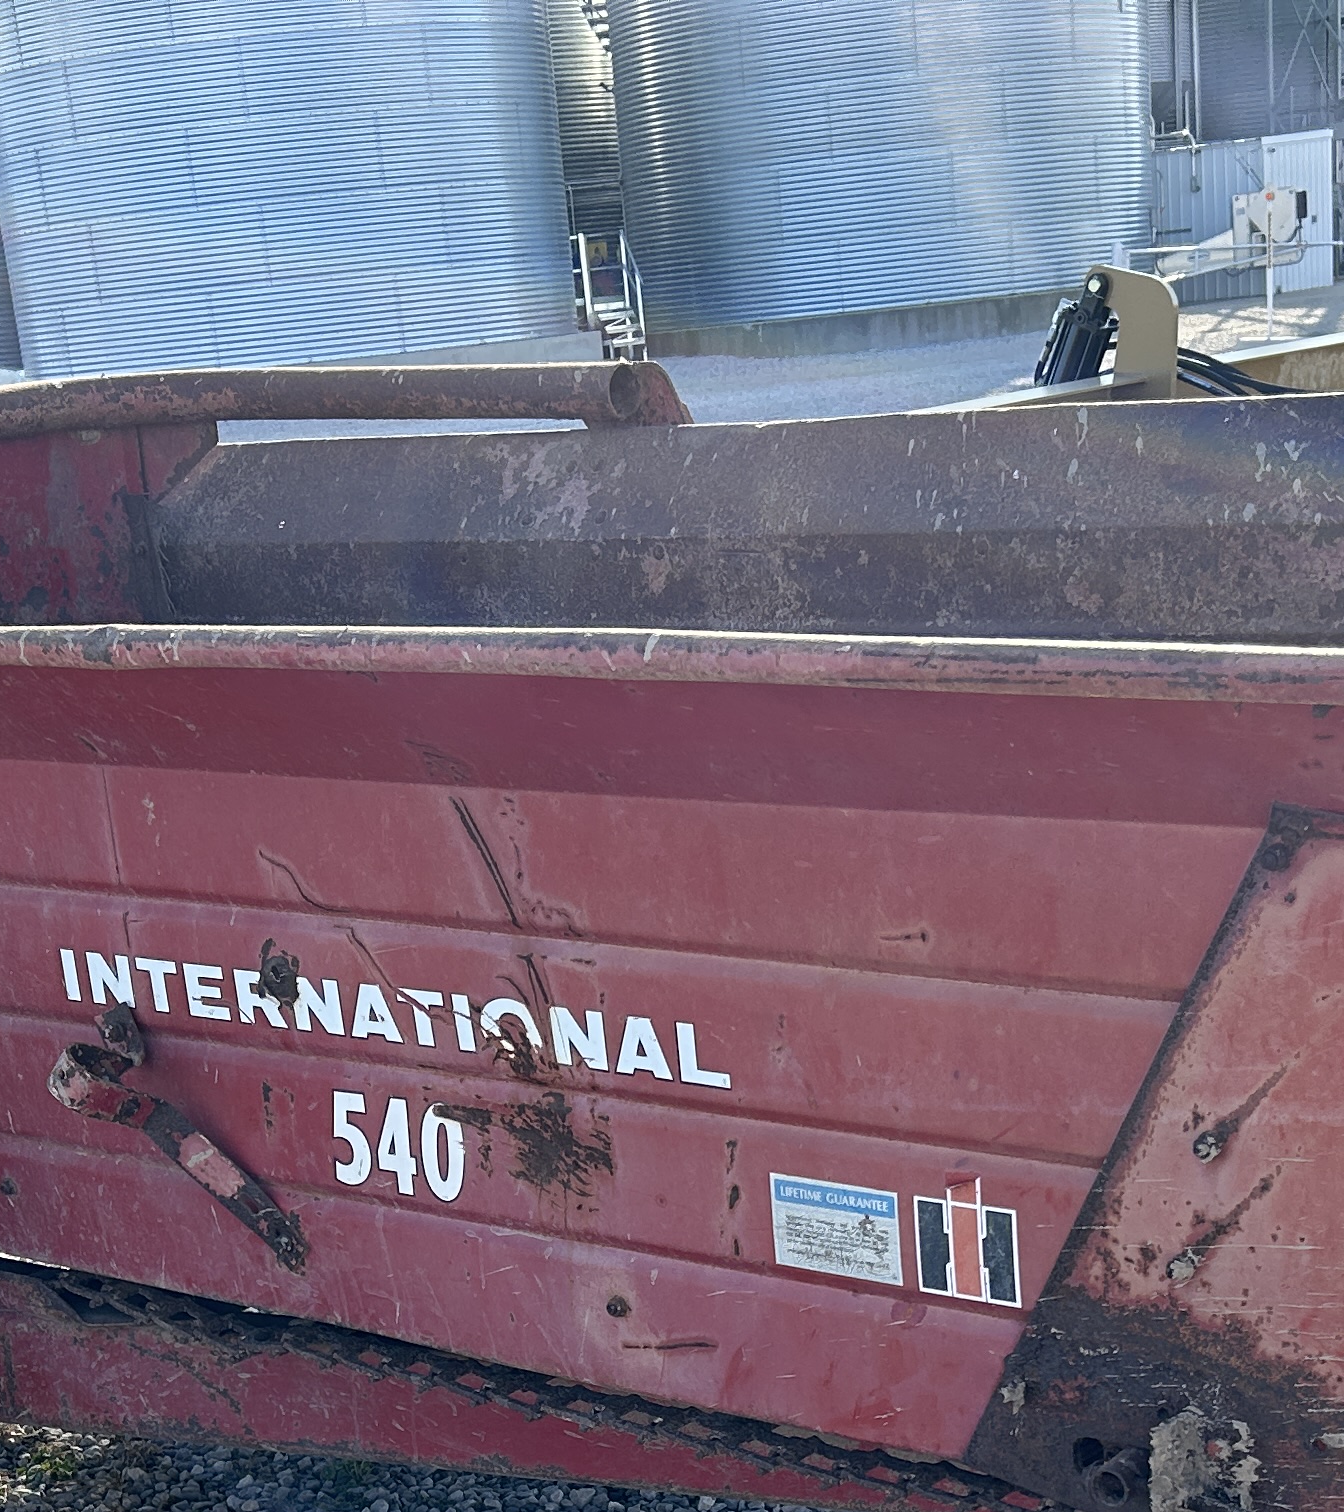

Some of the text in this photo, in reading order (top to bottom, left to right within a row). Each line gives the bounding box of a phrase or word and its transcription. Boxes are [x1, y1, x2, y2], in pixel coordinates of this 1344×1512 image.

[59, 947, 732, 1090] INTERNATIONAL
[332, 1090, 466, 1201] 540
[779, 1185, 889, 1213] LIFETIME GUARANTEE
